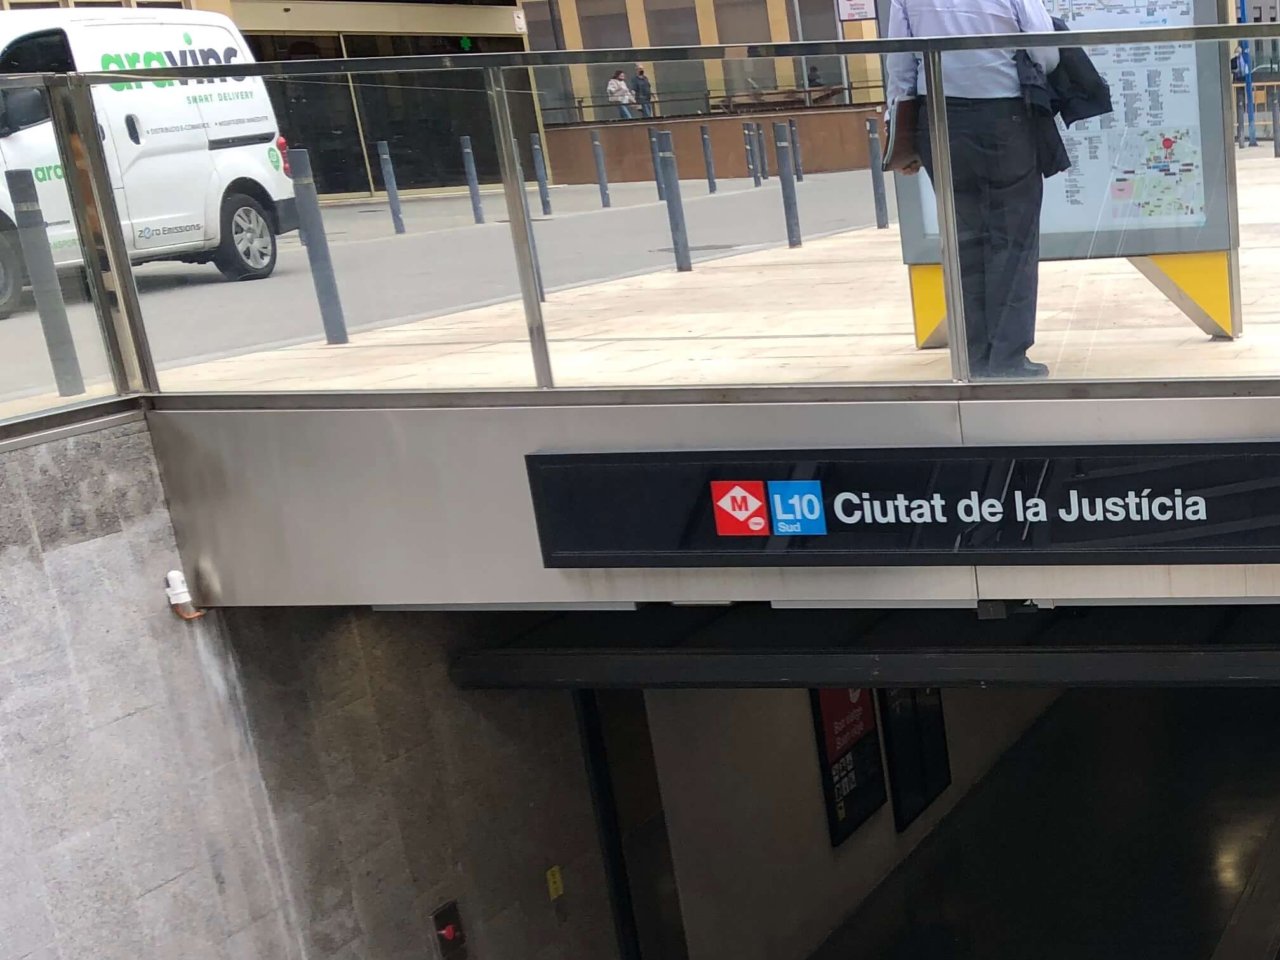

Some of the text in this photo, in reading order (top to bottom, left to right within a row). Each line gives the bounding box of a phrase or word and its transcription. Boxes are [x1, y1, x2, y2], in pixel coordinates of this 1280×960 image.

[186, 91, 254, 105] SMART DELIVERY
[773, 494, 820, 520] L10
[833, 488, 1207, 523] Ciutat de la Justícia
[778, 522, 801, 532] Sud
